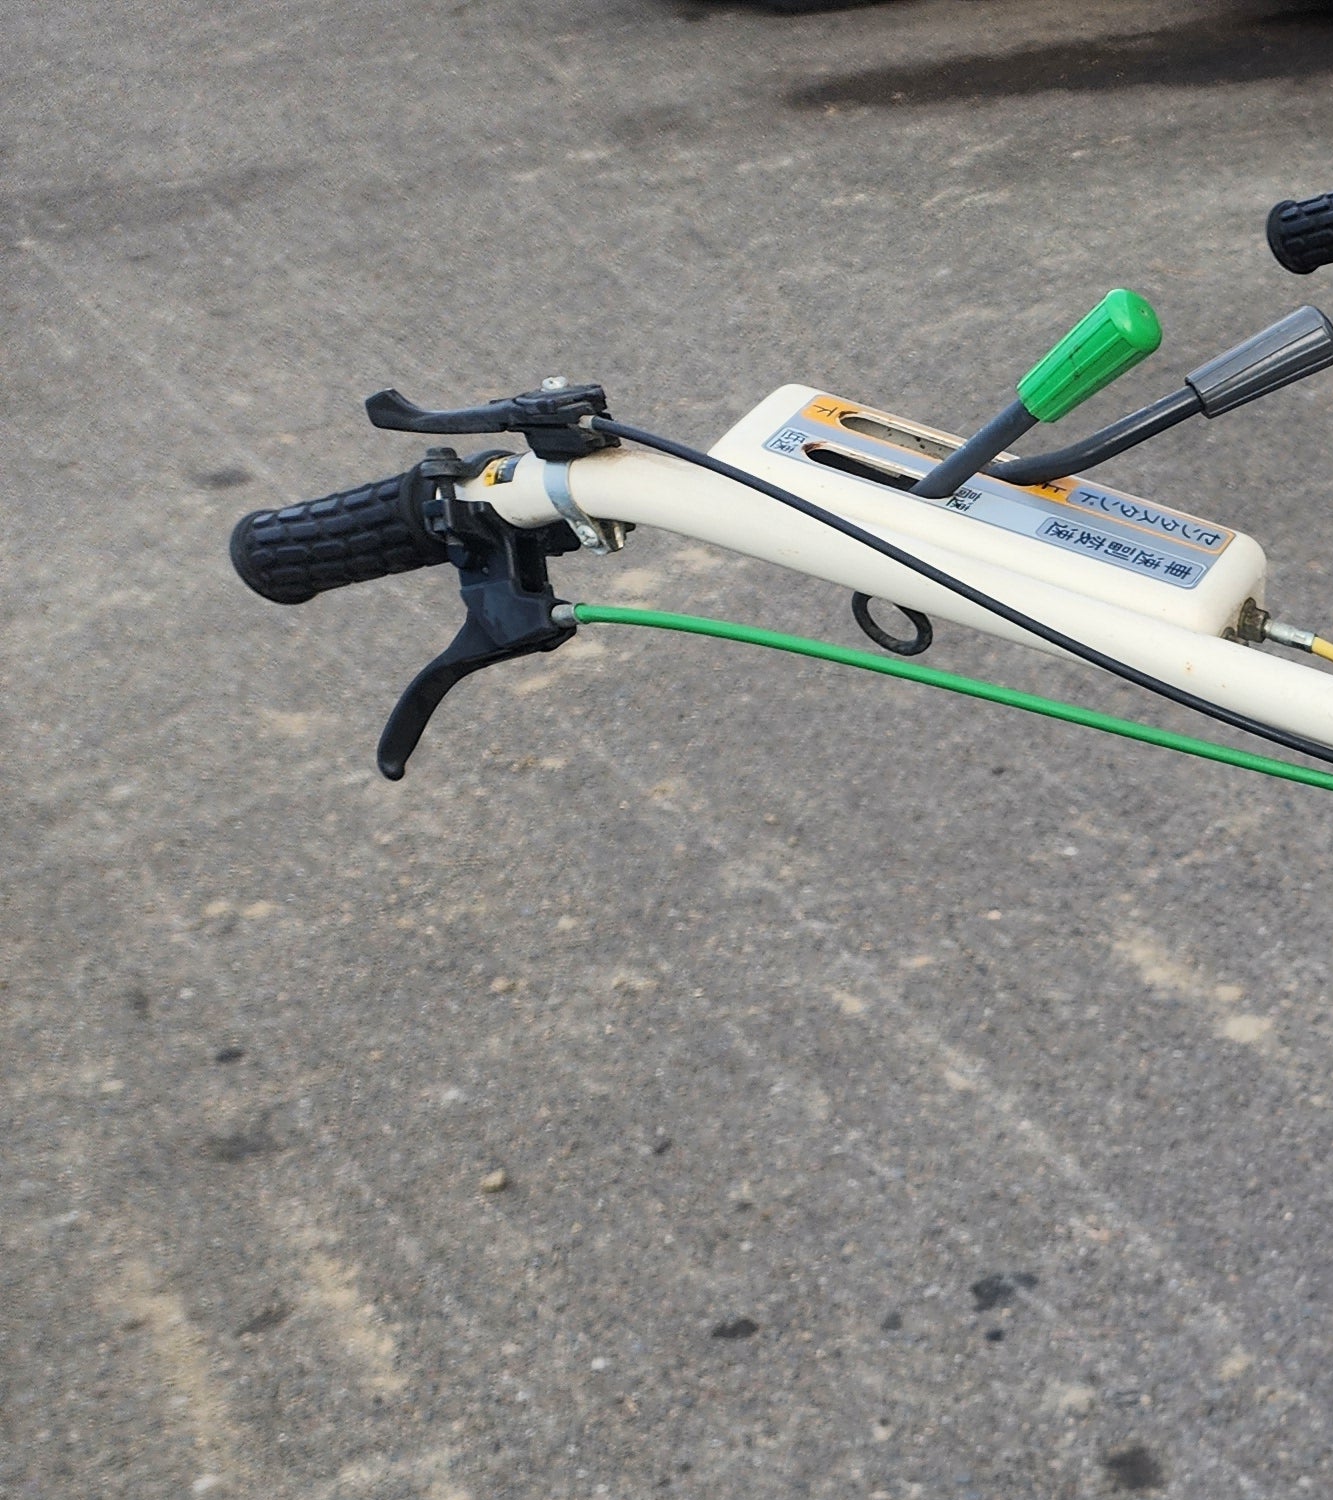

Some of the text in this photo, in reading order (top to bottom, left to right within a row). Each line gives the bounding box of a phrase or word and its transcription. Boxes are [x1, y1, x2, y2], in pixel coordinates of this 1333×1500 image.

[812, 404, 838, 417] 下
[769, 429, 809, 454] 低速
[1078, 490, 1221, 546] センタスタンド
[1043, 520, 1193, 580] 車速副変速
